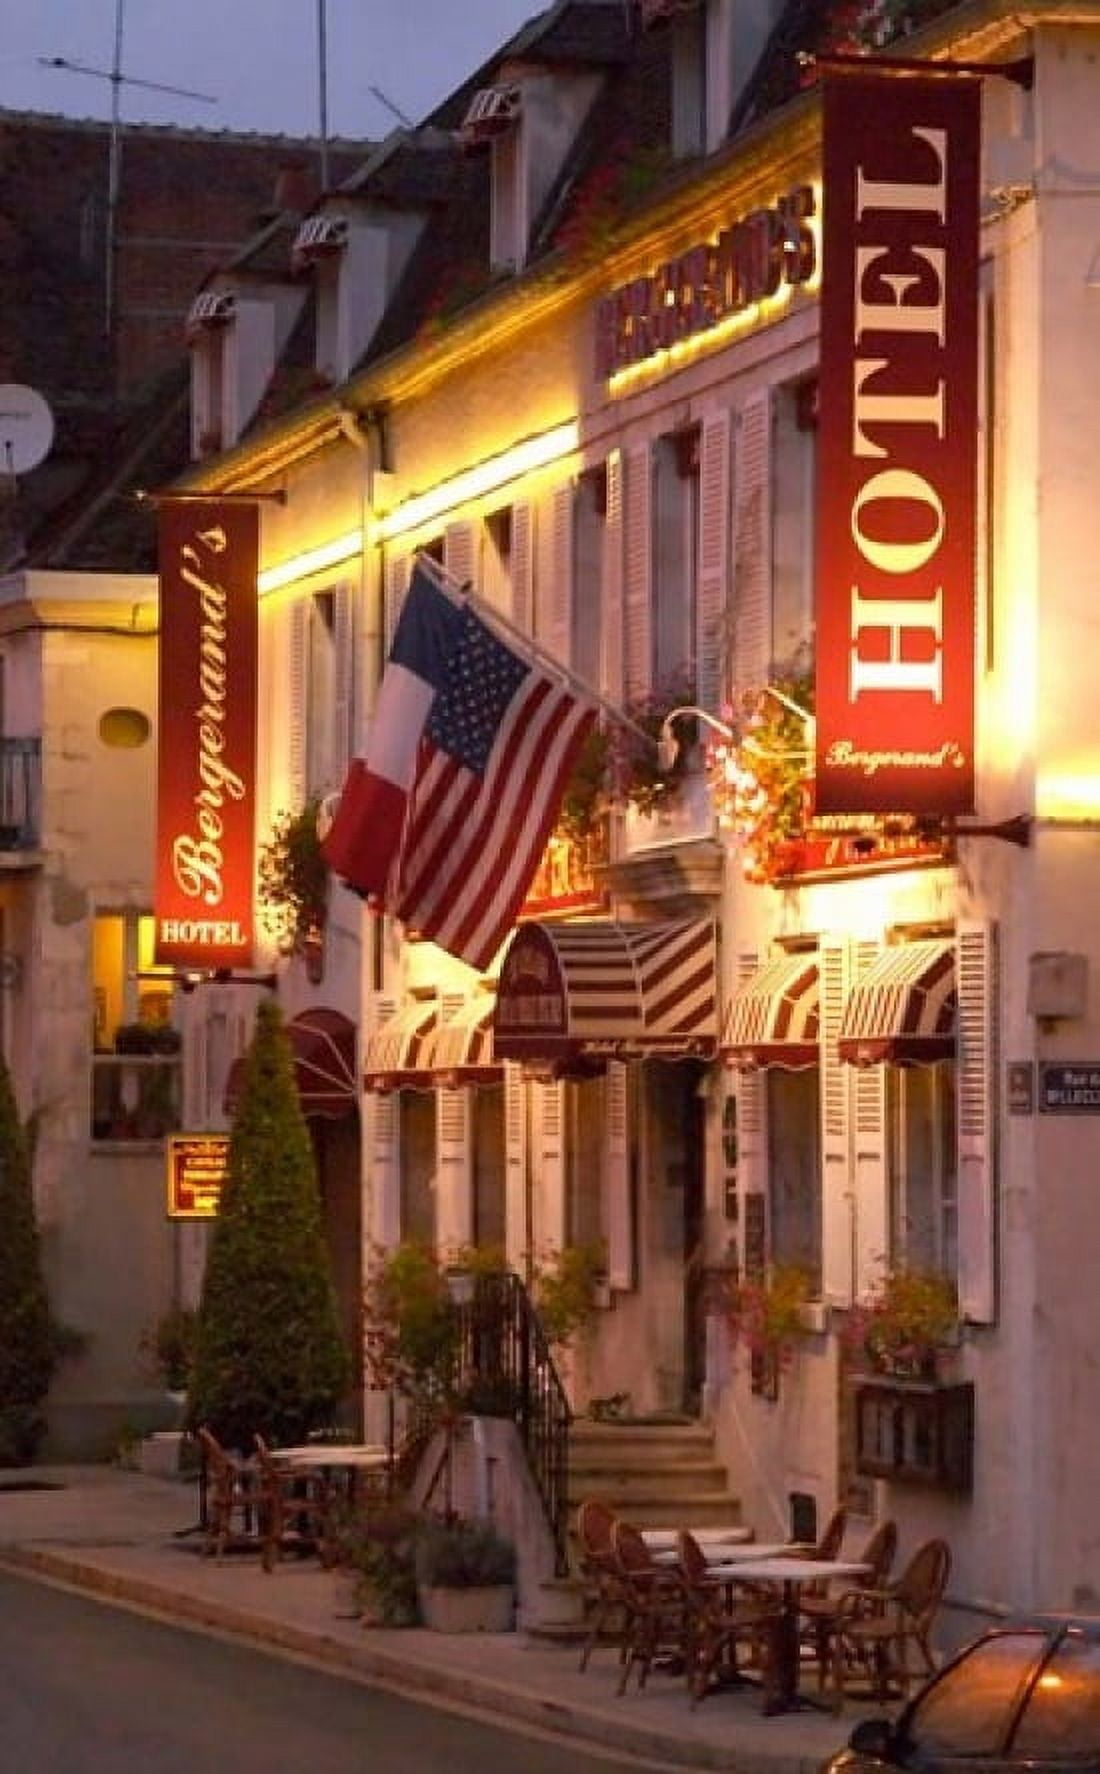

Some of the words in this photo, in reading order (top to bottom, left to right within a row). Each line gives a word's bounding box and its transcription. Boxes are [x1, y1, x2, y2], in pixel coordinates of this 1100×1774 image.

[850, 126, 949, 704] HOTEL
[173, 525, 246, 906] Bergerand's
[160, 919, 248, 946] HOTEL
